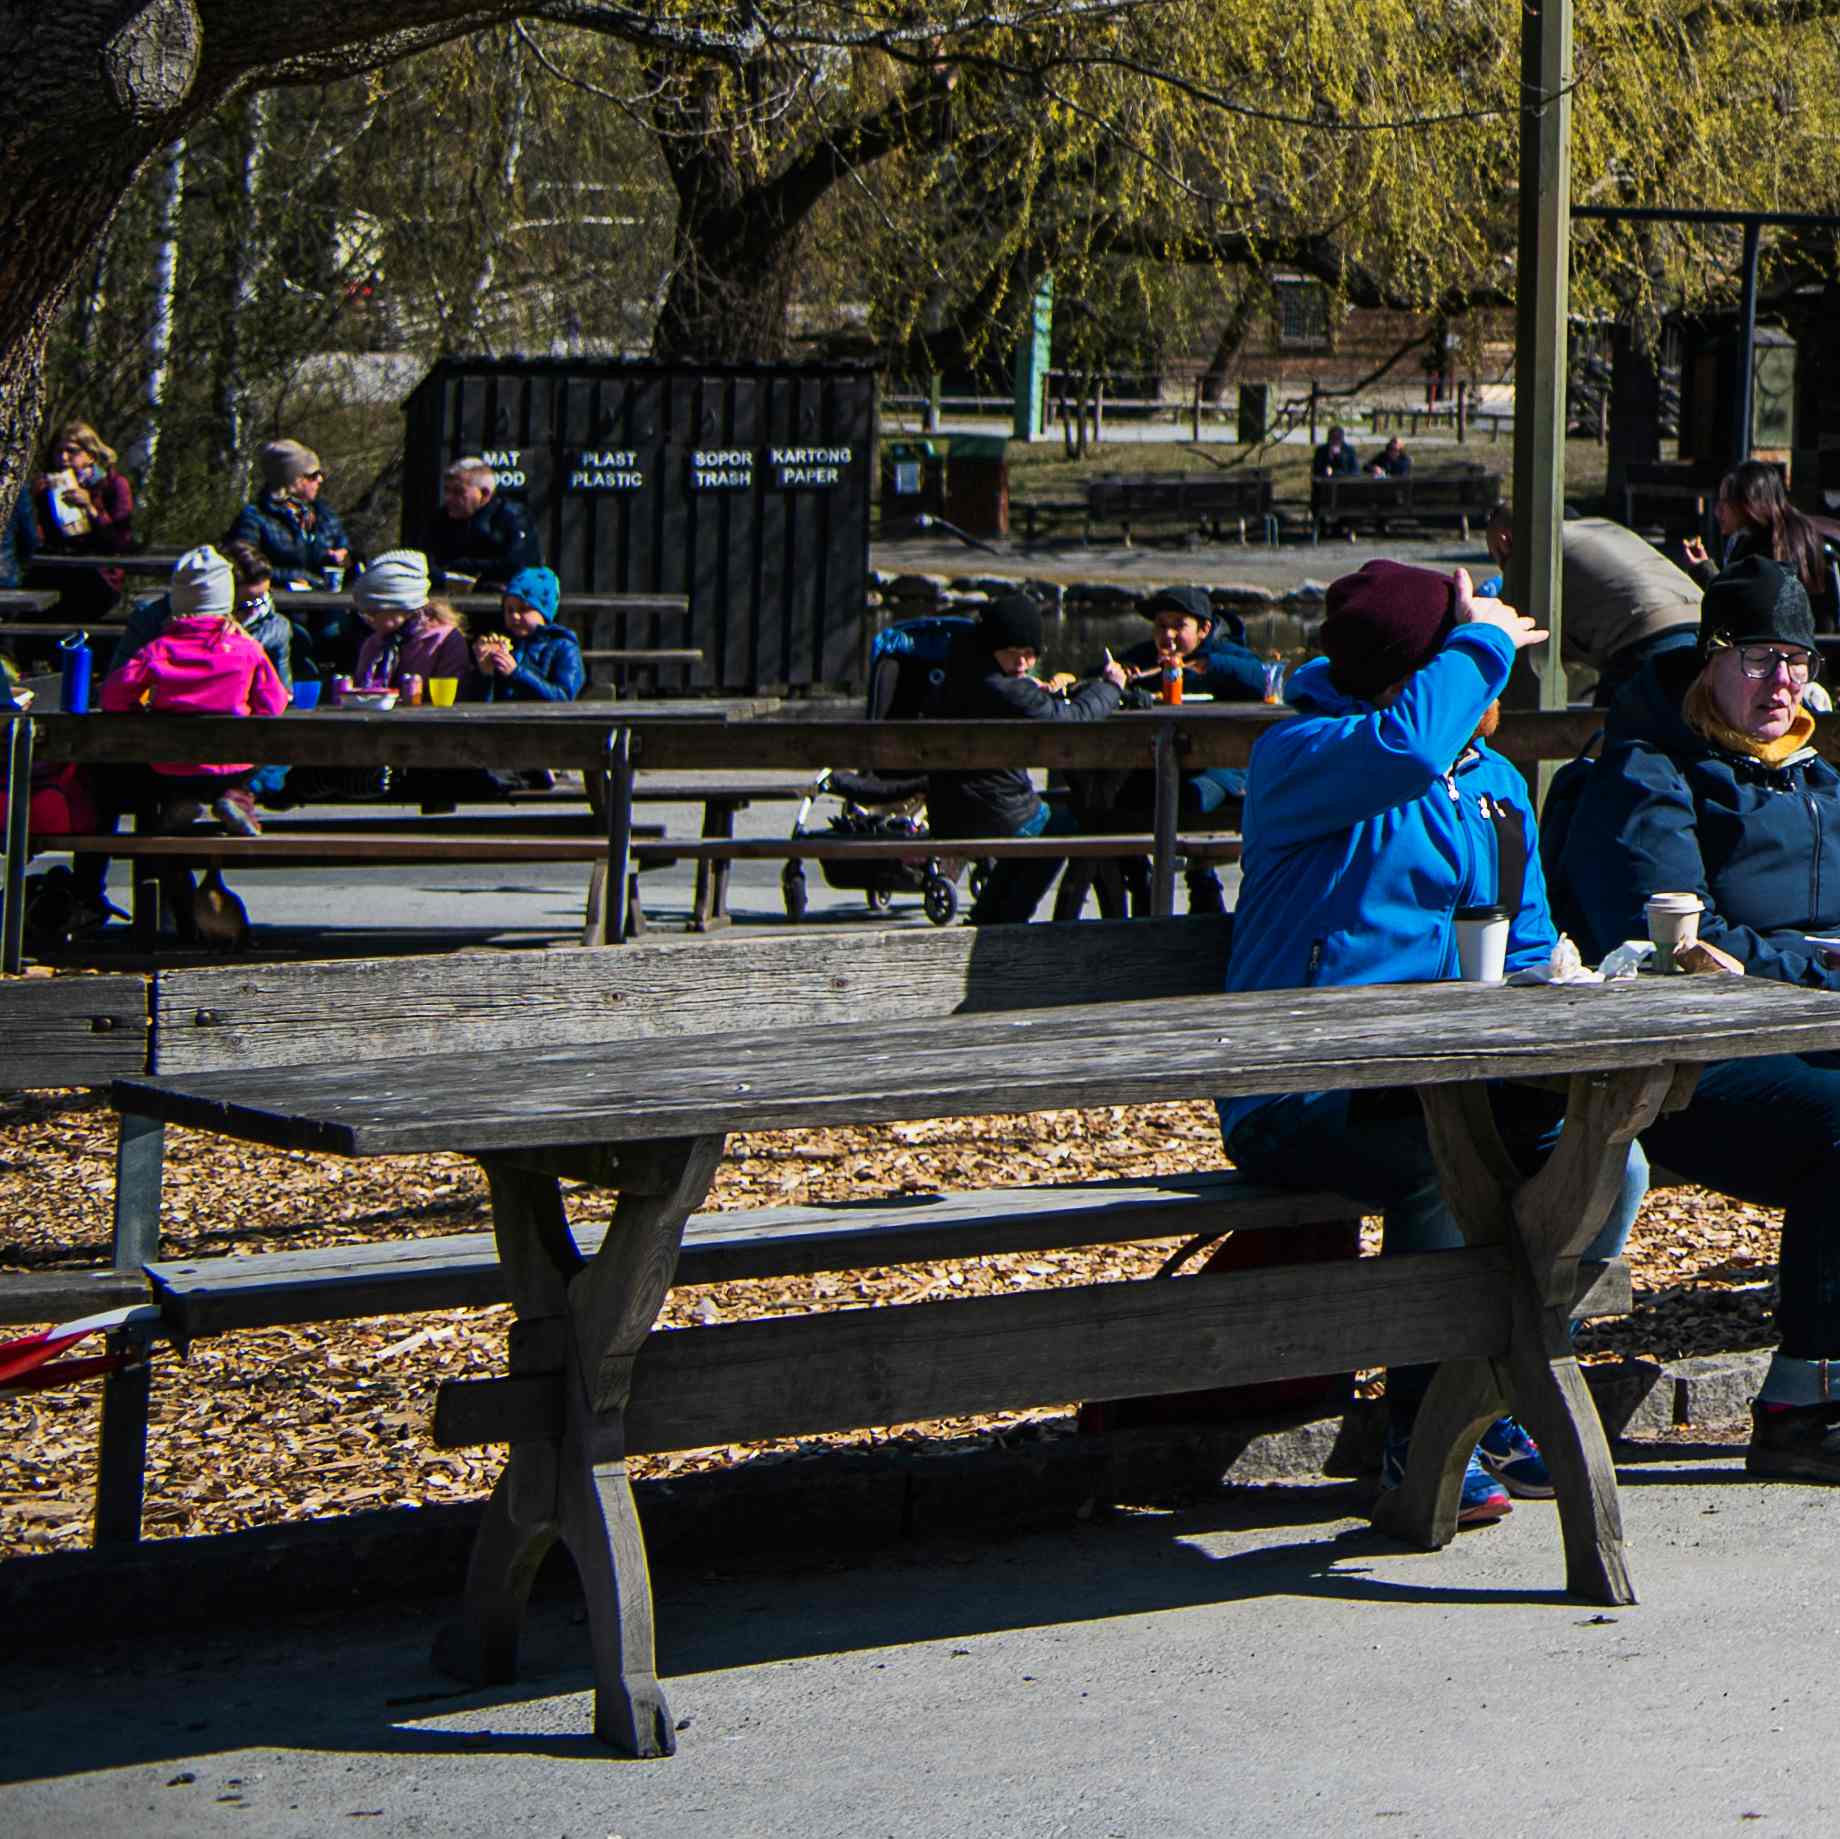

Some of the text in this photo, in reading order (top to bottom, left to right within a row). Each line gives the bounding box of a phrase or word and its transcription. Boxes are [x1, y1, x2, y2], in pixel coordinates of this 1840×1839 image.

[483, 450, 521, 467] MAT
[582, 450, 638, 467] PLAST
[694, 450, 753, 467] SOPOR
[771, 448, 852, 464] KARTONG
[572, 471, 643, 487] PLASTIC
[695, 470, 752, 487] TRASH
[784, 467, 839, 484] PAPER
